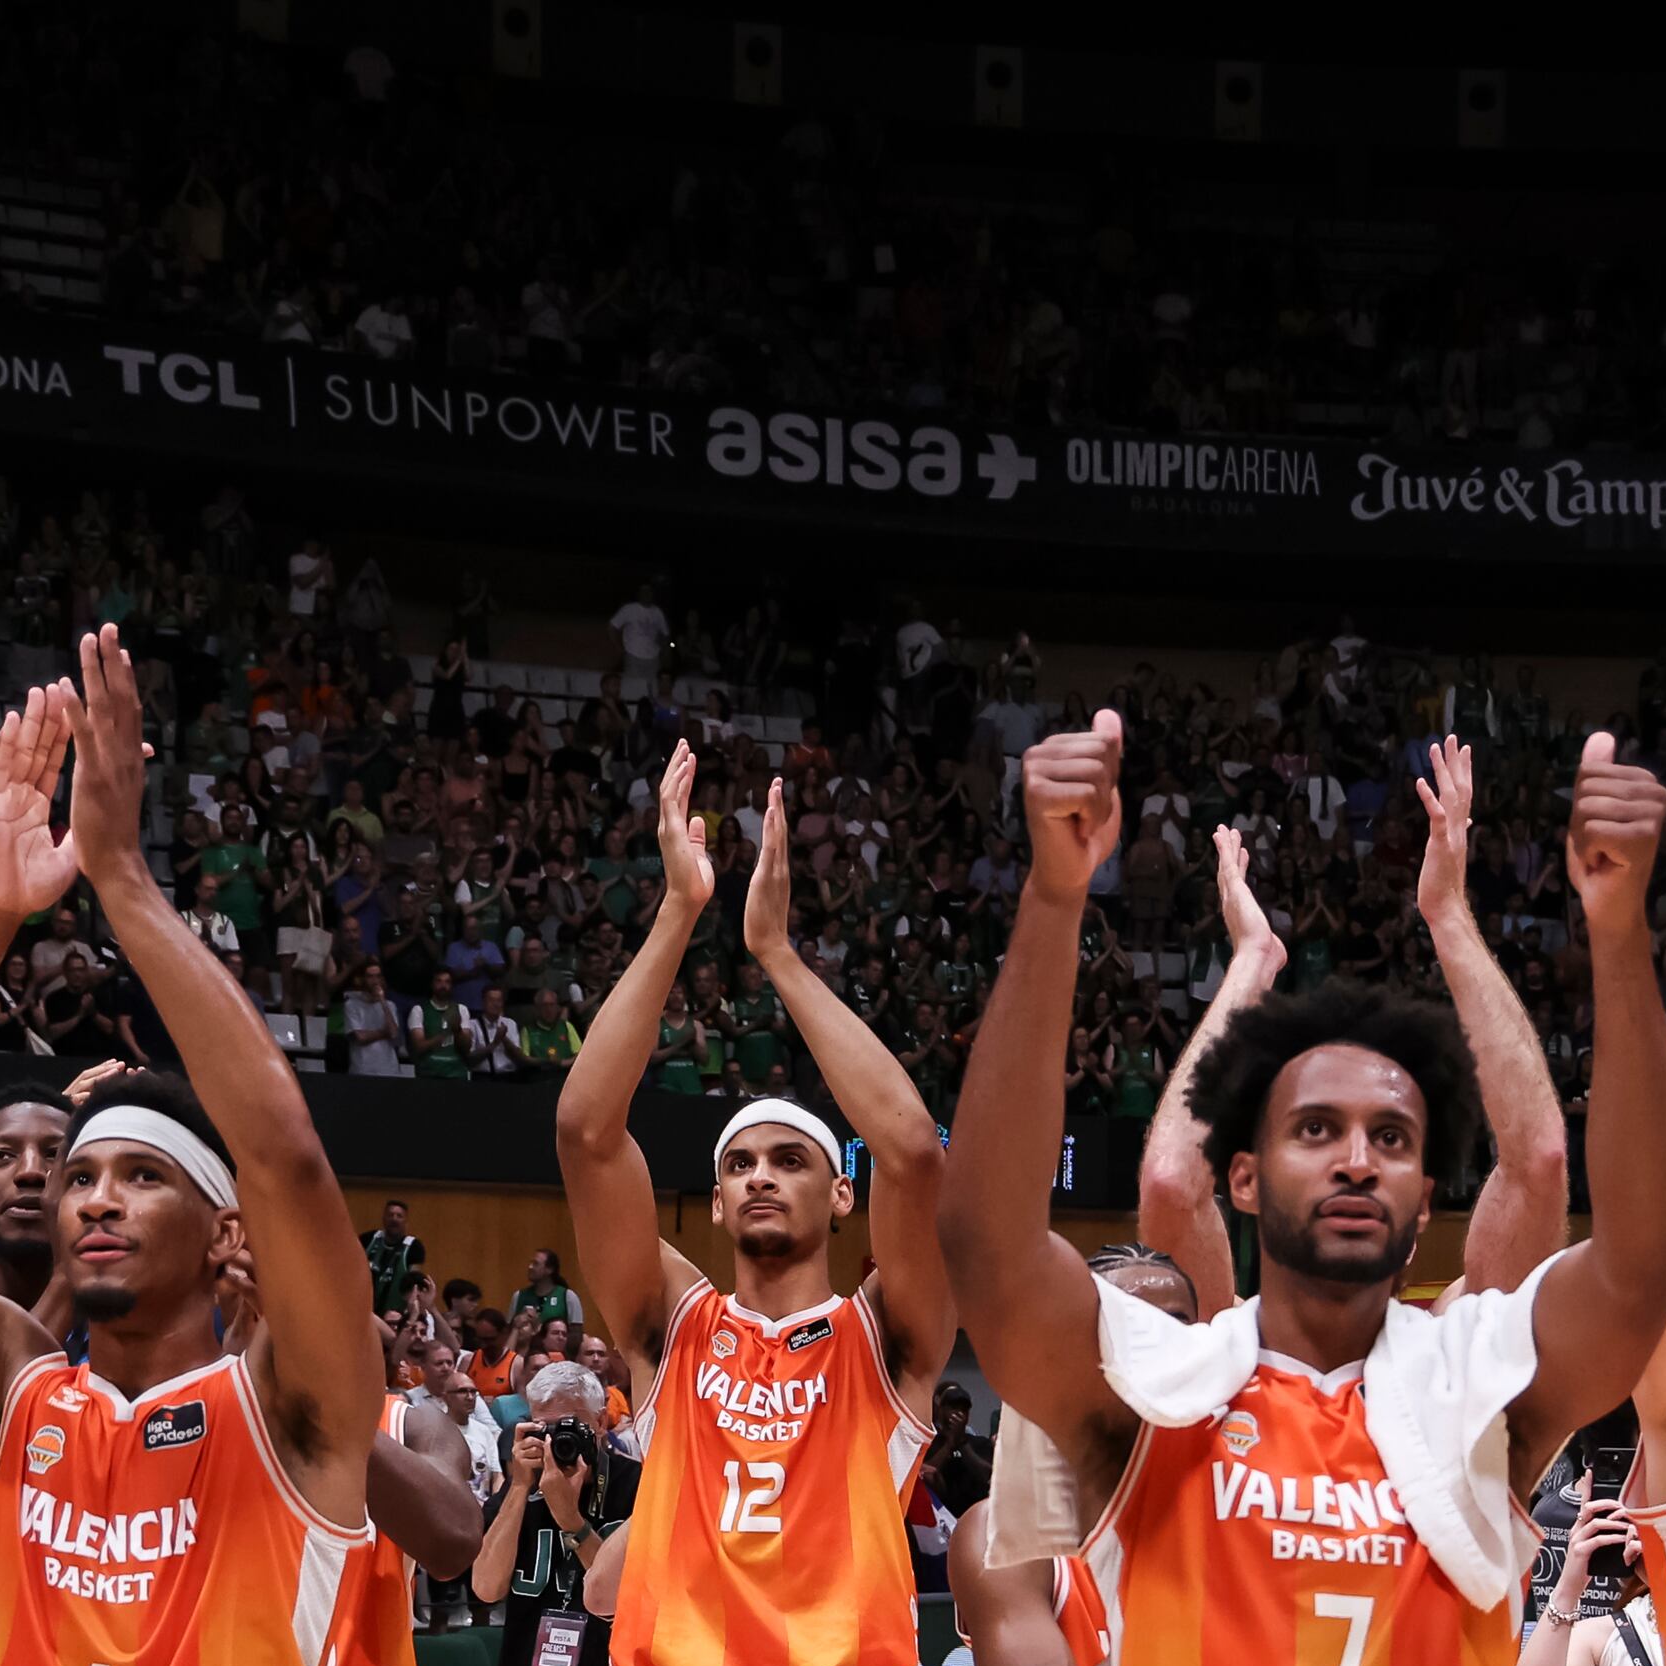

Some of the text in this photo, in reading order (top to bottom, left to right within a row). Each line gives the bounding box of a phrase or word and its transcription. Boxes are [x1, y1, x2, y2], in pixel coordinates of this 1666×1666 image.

[103, 344, 676, 457] TCL SUNPOWER
[705, 406, 962, 497] asisa
[1066, 437, 1320, 496] OLIMPICARENA
[1350, 453, 1482, 521] Juvé
[1494, 467, 1538, 522] &
[716, 1410, 803, 1443] BASKET
[20, 1483, 201, 1565] VALENCIA
[721, 1460, 785, 1533] 12
[44, 1560, 157, 1604] BASKET
[1272, 1529, 1406, 1566] BASKET
